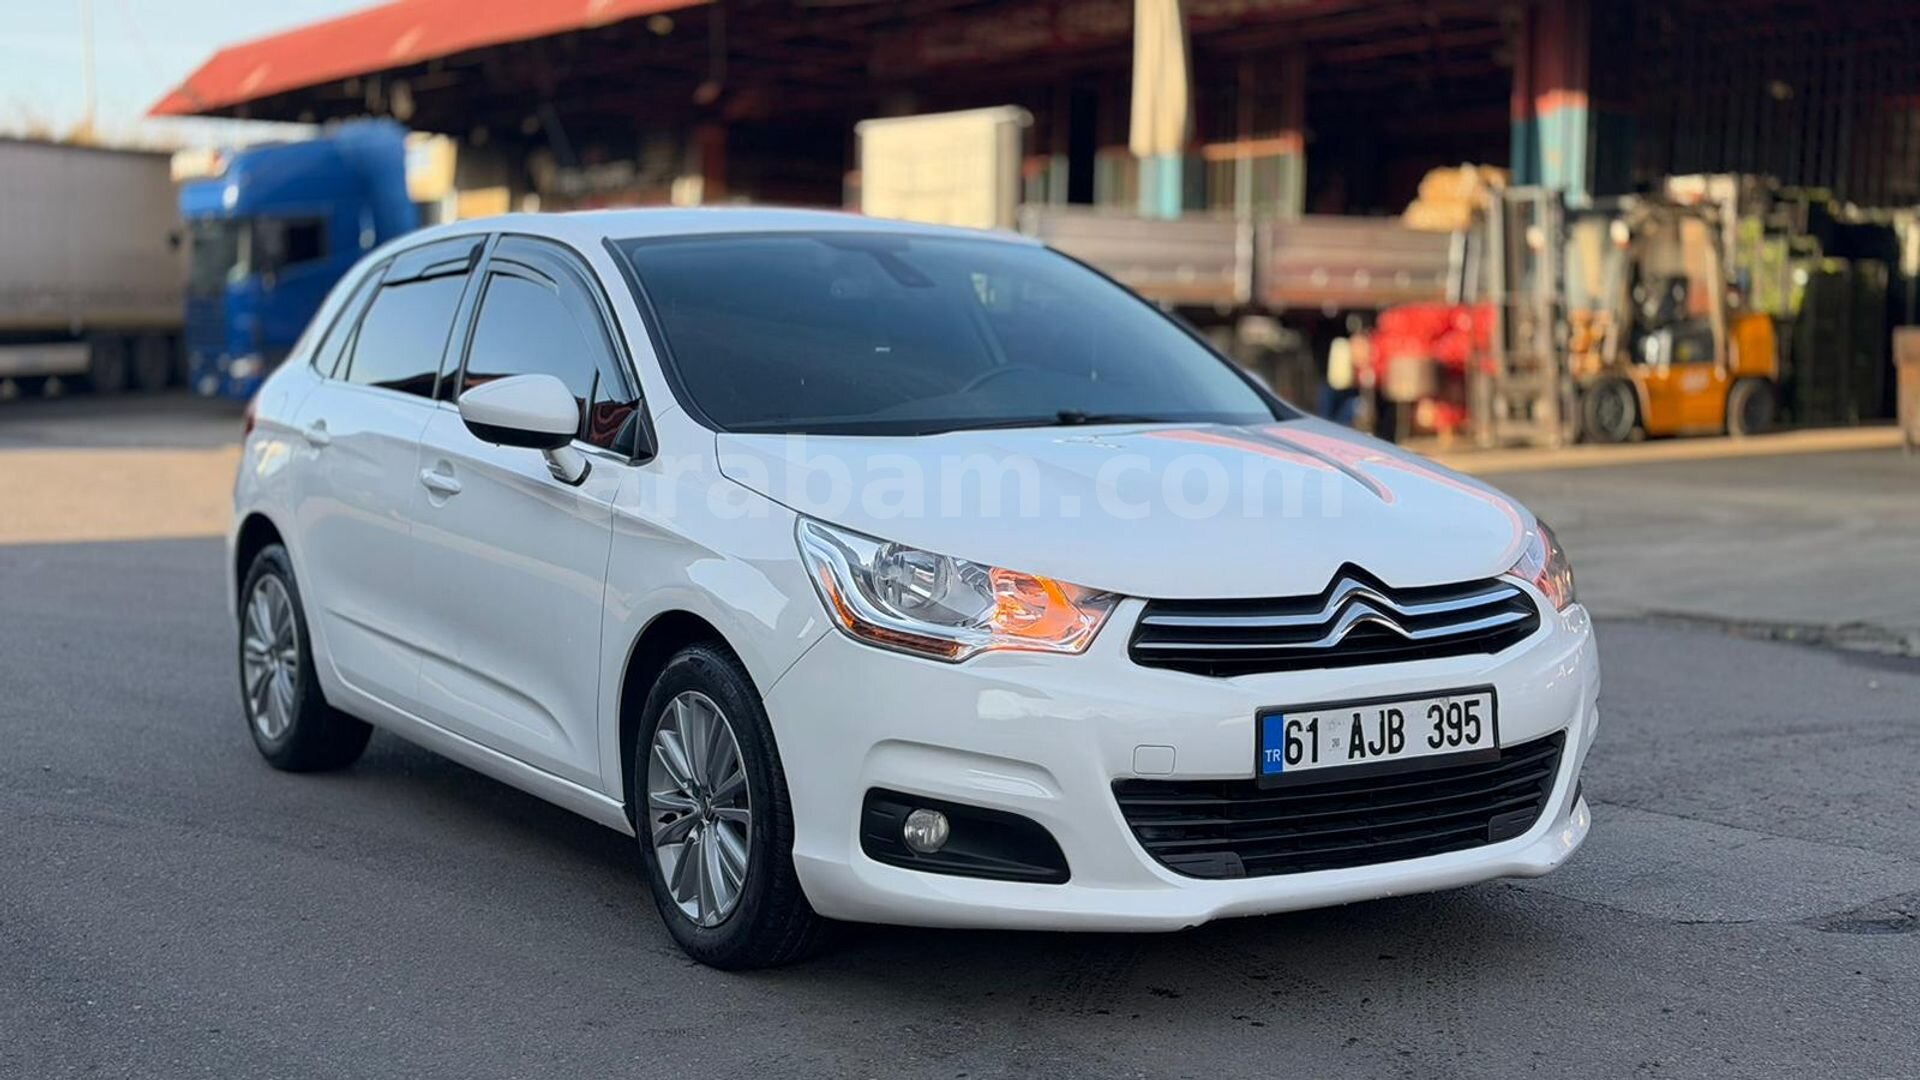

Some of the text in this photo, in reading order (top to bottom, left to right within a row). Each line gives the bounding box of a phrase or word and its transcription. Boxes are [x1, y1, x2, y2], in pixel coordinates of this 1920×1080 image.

[1284, 699, 1481, 766] 61 AJB 395
[1264, 748, 1281, 763] TR
